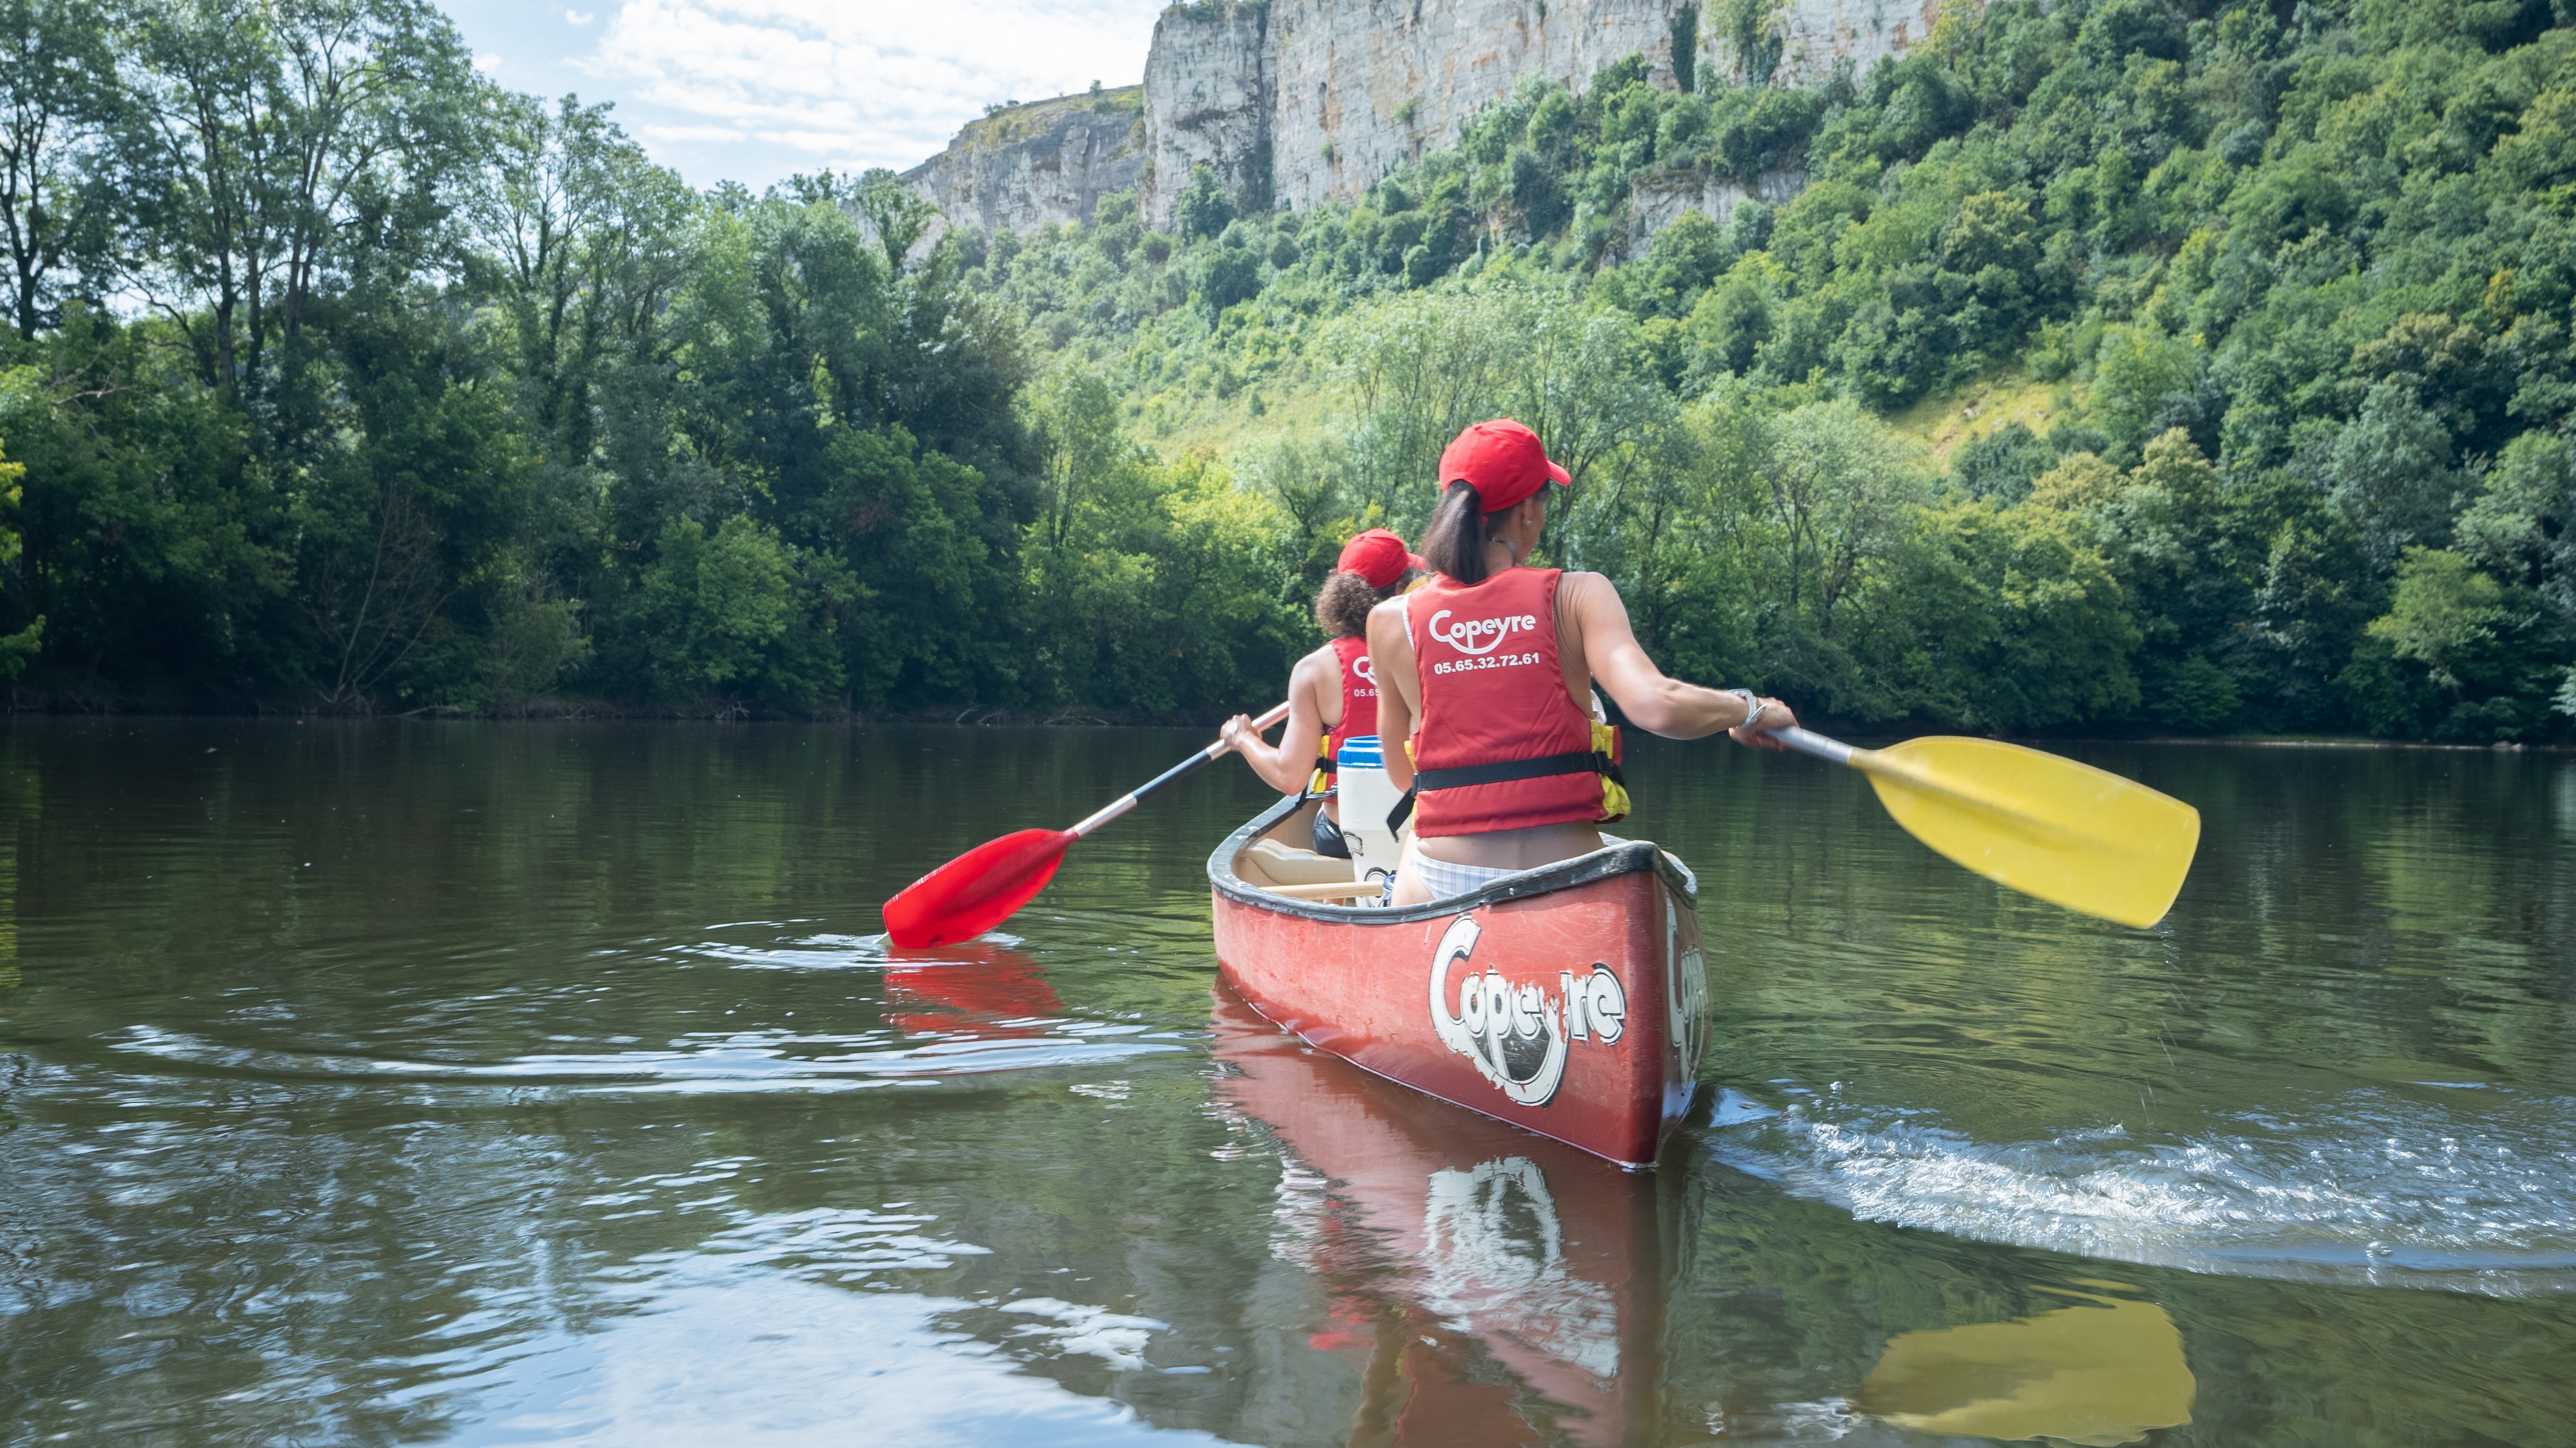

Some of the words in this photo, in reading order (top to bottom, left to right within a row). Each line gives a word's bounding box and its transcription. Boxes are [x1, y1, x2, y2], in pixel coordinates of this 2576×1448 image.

[1429, 609, 1536, 655] Copeyre
[1352, 656, 1378, 686] Co
[1434, 652, 1540, 675] 05.65.32.72.61
[1354, 688, 1380, 697] 05.65
[1429, 912, 1626, 1109] Copeyre
